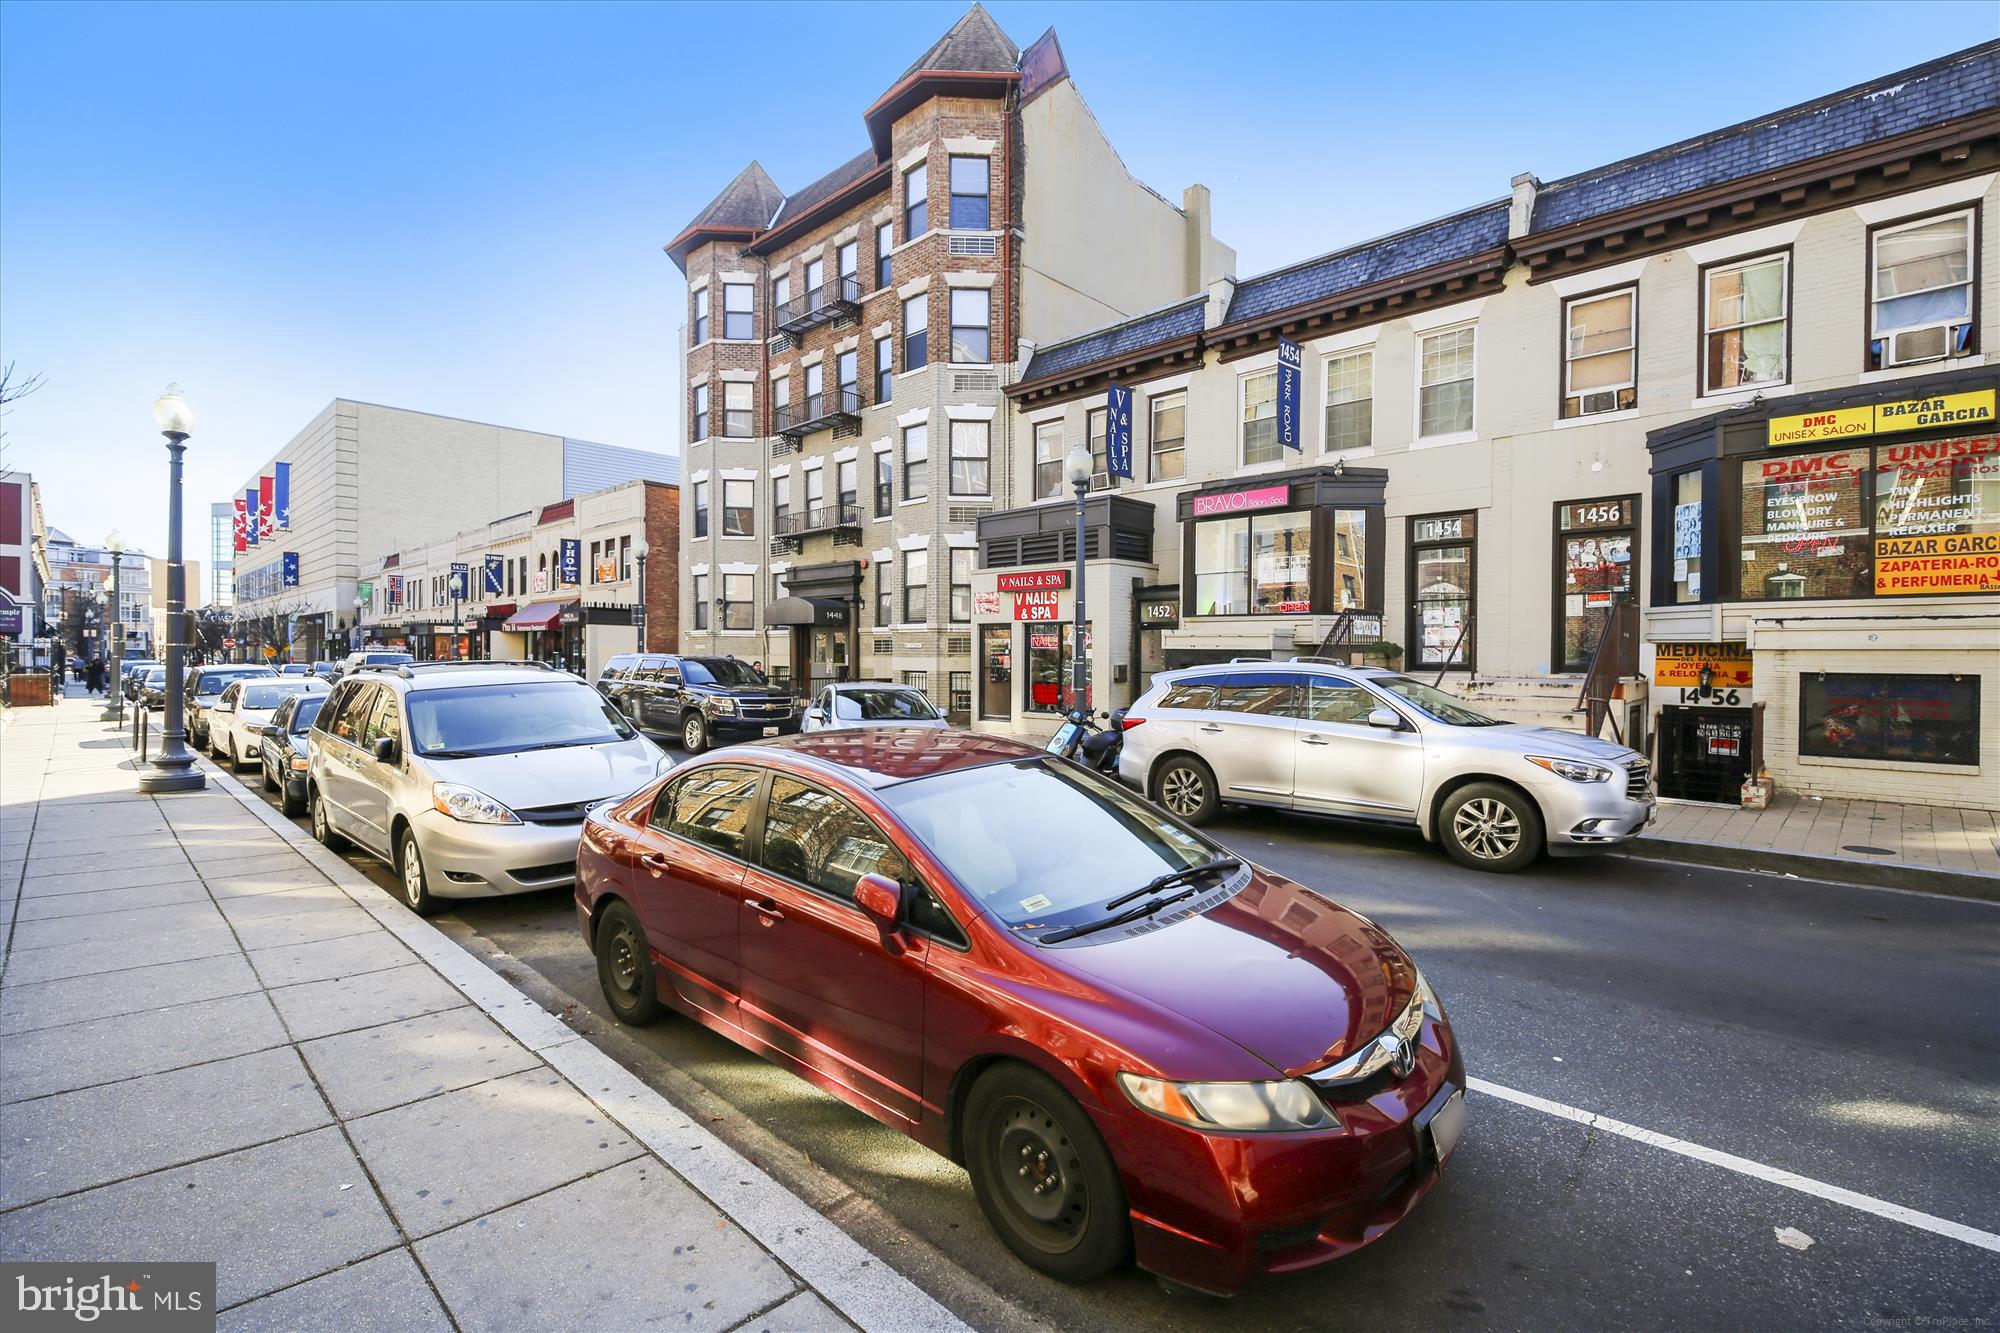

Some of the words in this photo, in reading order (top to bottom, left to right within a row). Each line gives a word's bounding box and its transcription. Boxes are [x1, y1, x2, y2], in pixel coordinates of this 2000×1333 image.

[1280, 343, 1300, 363] 1454
[1116, 389, 1126, 408] V
[1882, 399, 1945, 417] BAZAR
[1916, 406, 1989, 425] GARCIA
[1120, 413, 1128, 426] &
[1284, 405, 1292, 442] ROAD
[1803, 414, 1837, 428] DMC
[1110, 407, 1119, 470] NAILS
[1774, 429, 1816, 442] UNISEX
[1823, 422, 1867, 436] SALON
[1762, 453, 1850, 477] DMC
[1578, 505, 1620, 524] 1456
[1836, 517, 1845, 527] &
[1426, 520, 1461, 537] 1454
[1889, 523, 1957, 536] RELAXER
[566, 541, 575, 565] PHO
[1878, 540, 1938, 556] BAZAR
[1001, 578, 1007, 587] V
[1009, 576, 1034, 587] NAILS
[1037, 575, 1042, 585] &
[1046, 575, 1061, 584] SPA
[1877, 577, 1887, 588] &
[1892, 573, 1989, 588] PERFUMERIA
[1016, 593, 1023, 605] V
[1026, 591, 1057, 606] NAILS
[1021, 608, 1028, 620] &
[1031, 607, 1051, 620] SPA
[1147, 605, 1170, 618] 1452
[1280, 602, 1309, 612] OPEN
[502, 623, 511, 631] Pho
[1680, 687, 1741, 706] 1456
